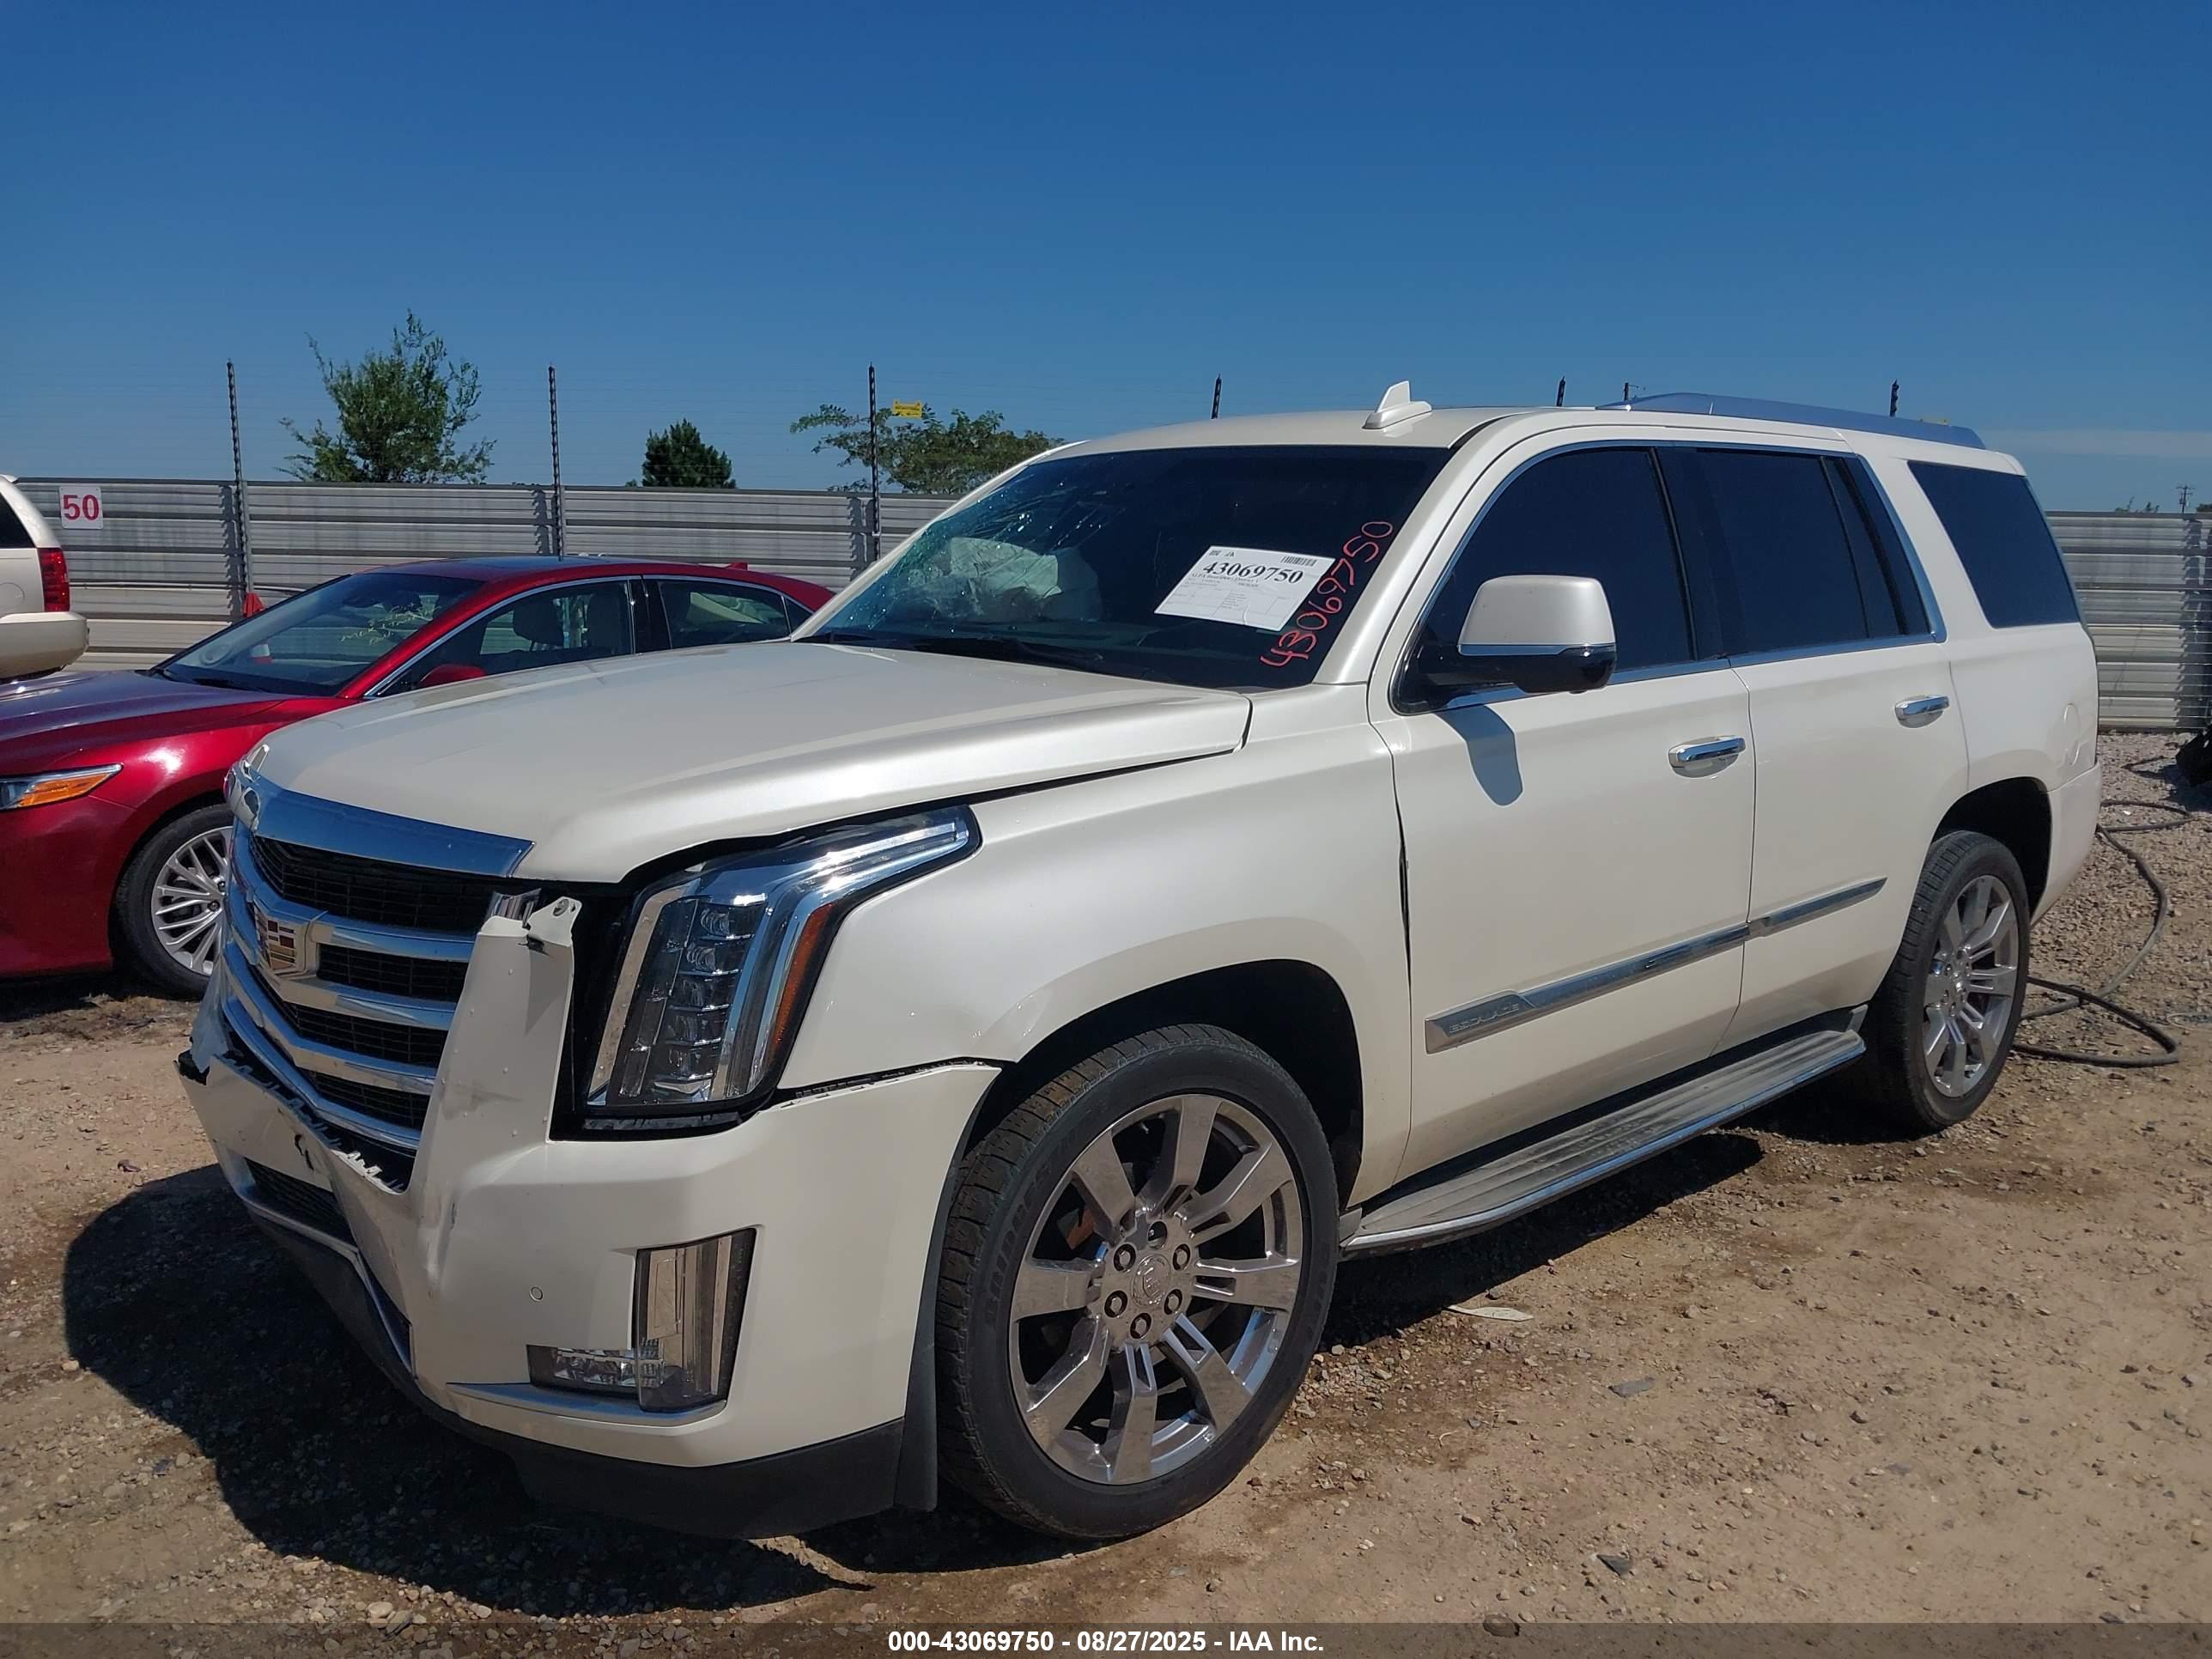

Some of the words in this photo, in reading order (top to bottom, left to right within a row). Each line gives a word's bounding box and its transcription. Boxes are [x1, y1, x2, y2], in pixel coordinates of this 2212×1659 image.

[63, 494, 100, 520] 50
[1202, 561, 1304, 585] 43069750
[1259, 520, 1394, 667] 43069750
